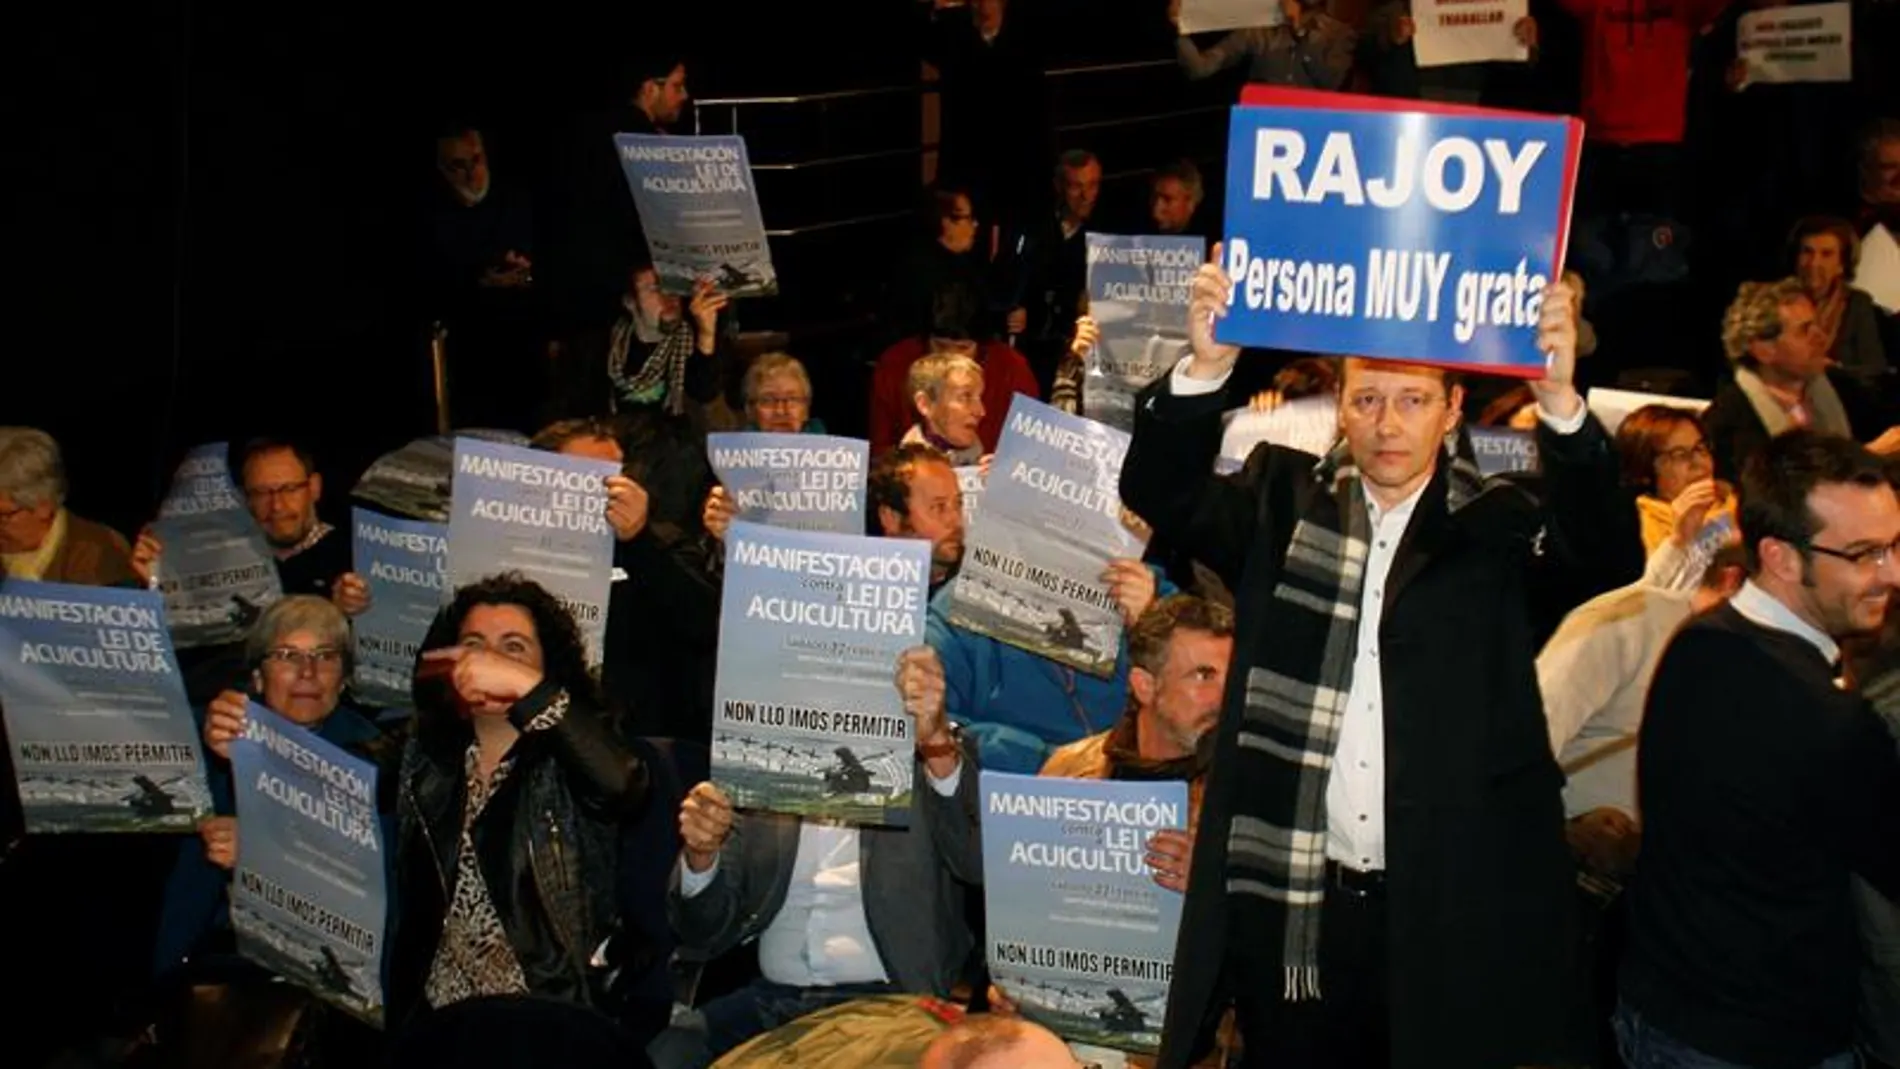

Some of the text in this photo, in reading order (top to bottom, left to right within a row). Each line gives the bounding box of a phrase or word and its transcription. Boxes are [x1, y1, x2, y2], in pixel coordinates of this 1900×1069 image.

[1252, 128, 1547, 214] RAJOY
[1226, 238, 1547, 344] Persona MUY grata
[714, 446, 861, 470] MANIFESTACIÓN
[802, 471, 828, 490] LEI
[833, 472, 859, 490] DE
[471, 497, 608, 536] ACUICULTURA
[552, 491, 580, 513] LEI
[738, 489, 858, 511] ACUICULTURA
[734, 540, 922, 582] MANIFESTACIÓN
[973, 547, 1000, 568] NON
[1002, 557, 1024, 578] LLO
[1026, 566, 1059, 592] IMOS
[800, 578, 919, 611] contra LEI DE
[747, 595, 915, 636] ACUICULTURA
[20, 640, 173, 675] ACUICULTURA
[100, 627, 166, 653] LEI DE
[724, 700, 907, 740] NON LLO IMOS PERMITIR
[256, 771, 378, 851] ACUICULTURA
[990, 791, 1178, 826] MANIFESTACIÓN
[1106, 827, 1138, 850] LEI
[997, 942, 1027, 963] NON
[1032, 947, 1055, 968] LLO
[1060, 950, 1098, 973] IMOS
